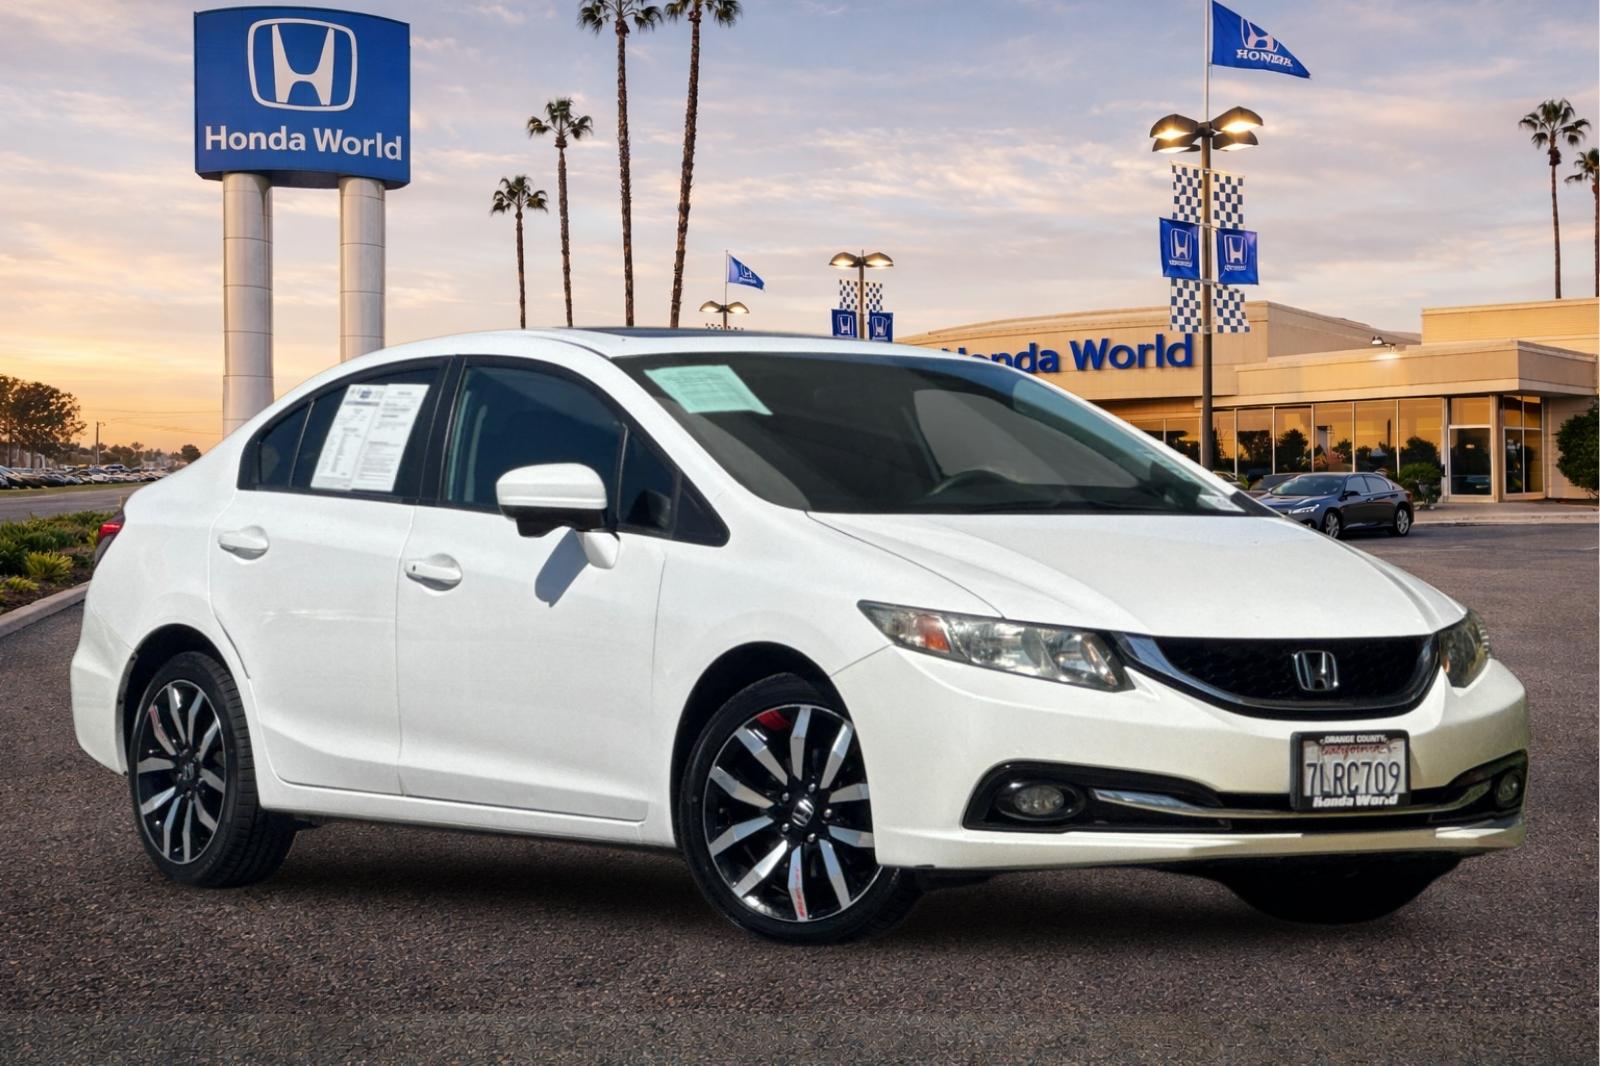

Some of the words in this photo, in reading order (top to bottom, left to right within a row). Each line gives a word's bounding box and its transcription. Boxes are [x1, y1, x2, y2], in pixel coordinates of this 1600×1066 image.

[205, 125, 306, 151] Honda
[313, 127, 402, 160] World
[941, 342, 1060, 373] nda
[1070, 334, 1194, 371] World
[1306, 761, 1400, 796] 7LRC709
[1313, 794, 1354, 808] Honda
